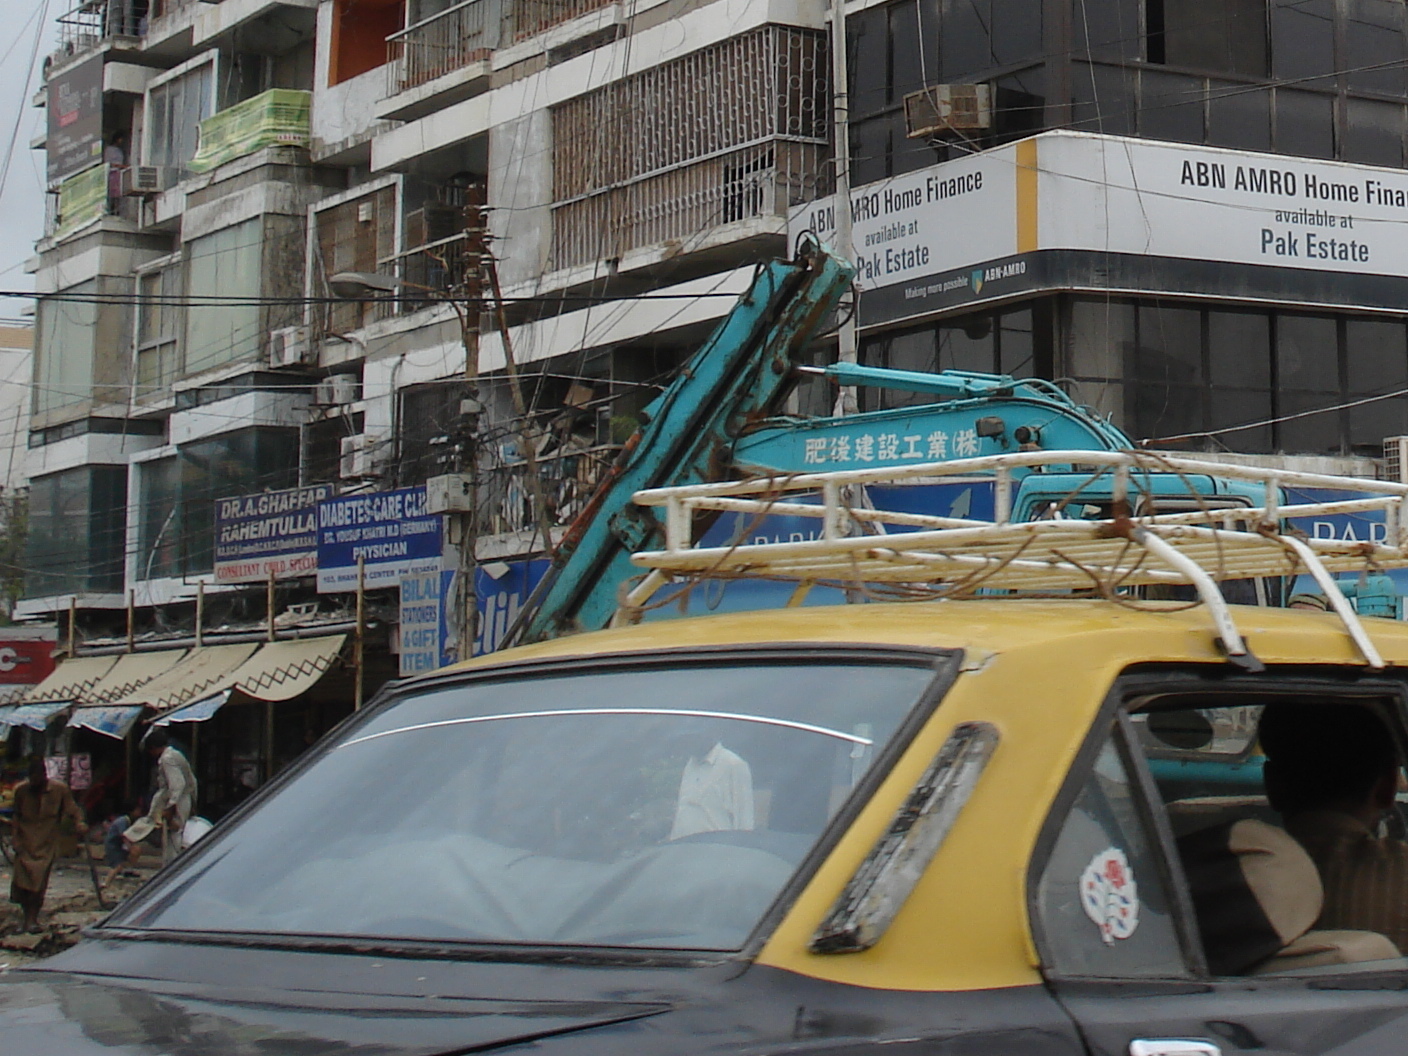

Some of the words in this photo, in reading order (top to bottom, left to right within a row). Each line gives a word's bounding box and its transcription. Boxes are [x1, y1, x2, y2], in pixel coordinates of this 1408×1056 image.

[1180, 159, 1227, 189] ABN
[1234, 165, 1297, 197] AMRO
[1304, 173, 1360, 203] Home
[808, 206, 836, 236] ABN
[850, 193, 880, 224] MRO
[884, 186, 922, 215] Home
[926, 170, 984, 203] Finance
[1275, 207, 1337, 228] available
[1340, 214, 1354, 230] at
[865, 220, 906, 247] available
[907, 219, 919, 236] at
[1261, 227, 1299, 258] Pak
[1306, 232, 1370, 263] Estate
[856, 255, 881, 282] Pak
[886, 244, 930, 274] Estate
[904, 284, 927, 301] Making
[220, 513, 318, 543] RAHEMTULLA
[352, 541, 408, 561] PHYSICIAN
[217, 562, 260, 580] CONSULTANT
[401, 575, 439, 604] BILAL
[410, 628, 437, 647] GIFT
[402, 651, 434, 671] ITEM
